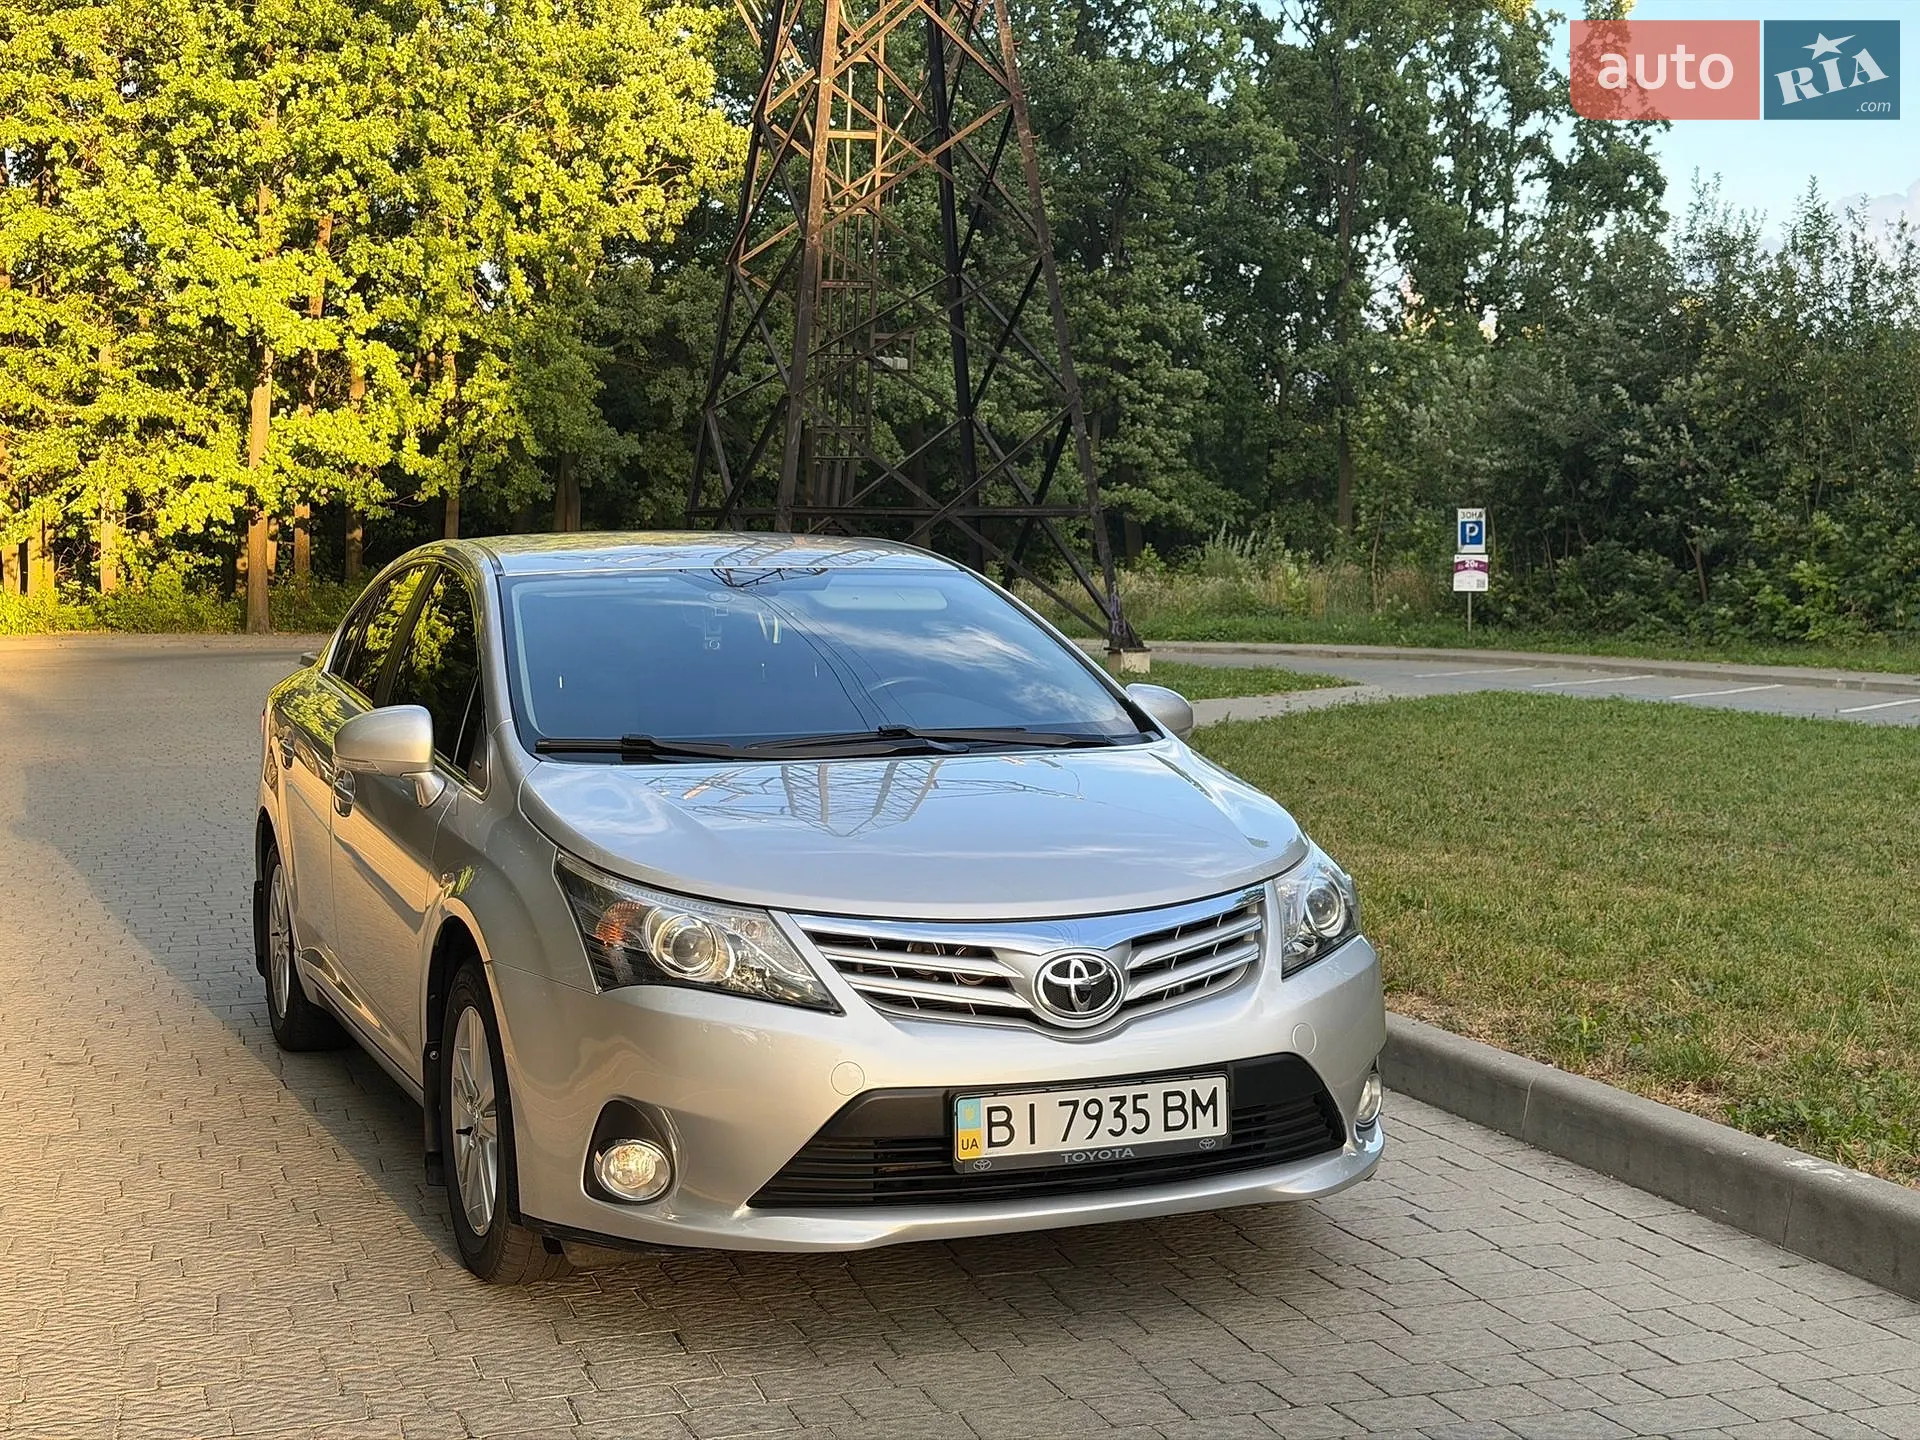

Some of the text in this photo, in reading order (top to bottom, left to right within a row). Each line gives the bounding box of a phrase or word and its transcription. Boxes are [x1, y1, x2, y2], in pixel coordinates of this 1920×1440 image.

[1461, 511, 1483, 519] ЗОНА
[1466, 523, 1479, 543] P
[986, 1086, 1218, 1149] BI 7935 BM
[960, 1137, 979, 1151] UA
[1061, 1147, 1135, 1163] TOYOTA
